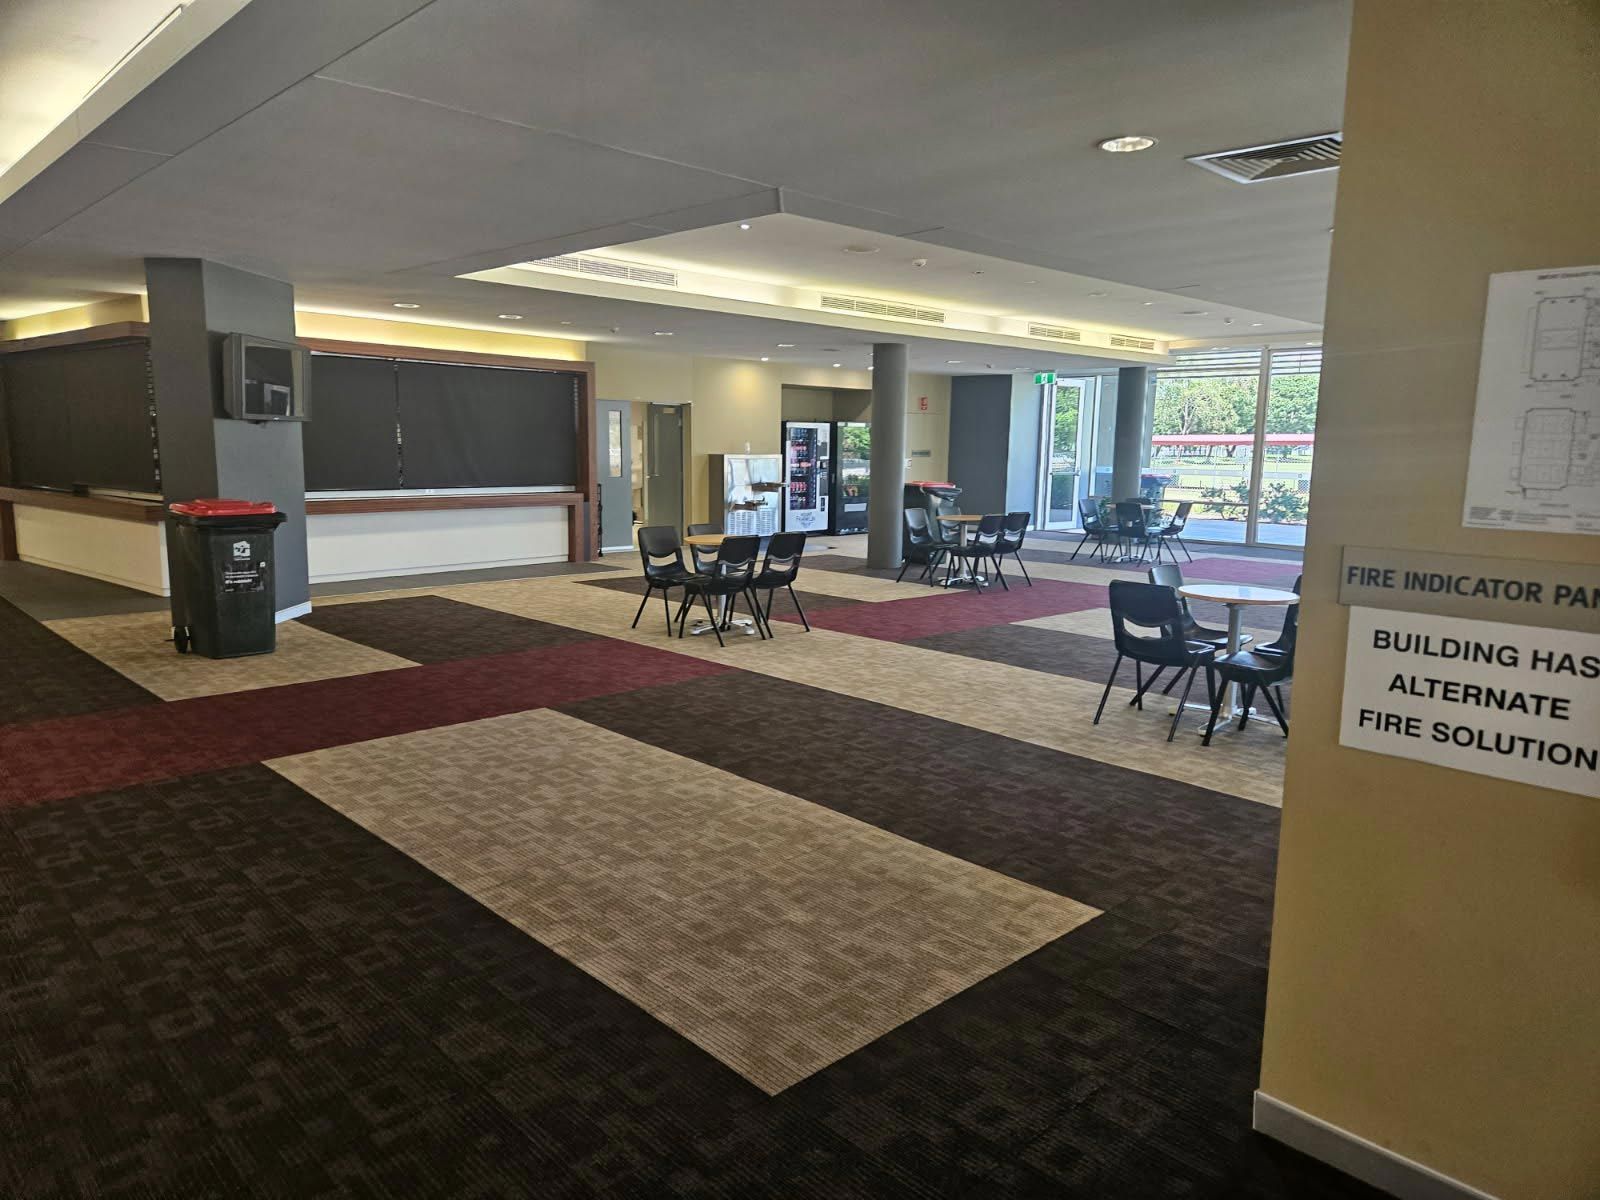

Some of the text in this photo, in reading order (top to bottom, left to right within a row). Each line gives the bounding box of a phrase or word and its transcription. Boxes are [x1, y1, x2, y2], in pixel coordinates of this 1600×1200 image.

[1346, 565, 1397, 589] FIRE
[1403, 570, 1544, 604] INDICATOR
[1372, 629, 1600, 680] BUILDING HAS
[1387, 673, 1572, 721] ALTERNATE
[1358, 708, 1599, 772] FIRE SOLUTION
